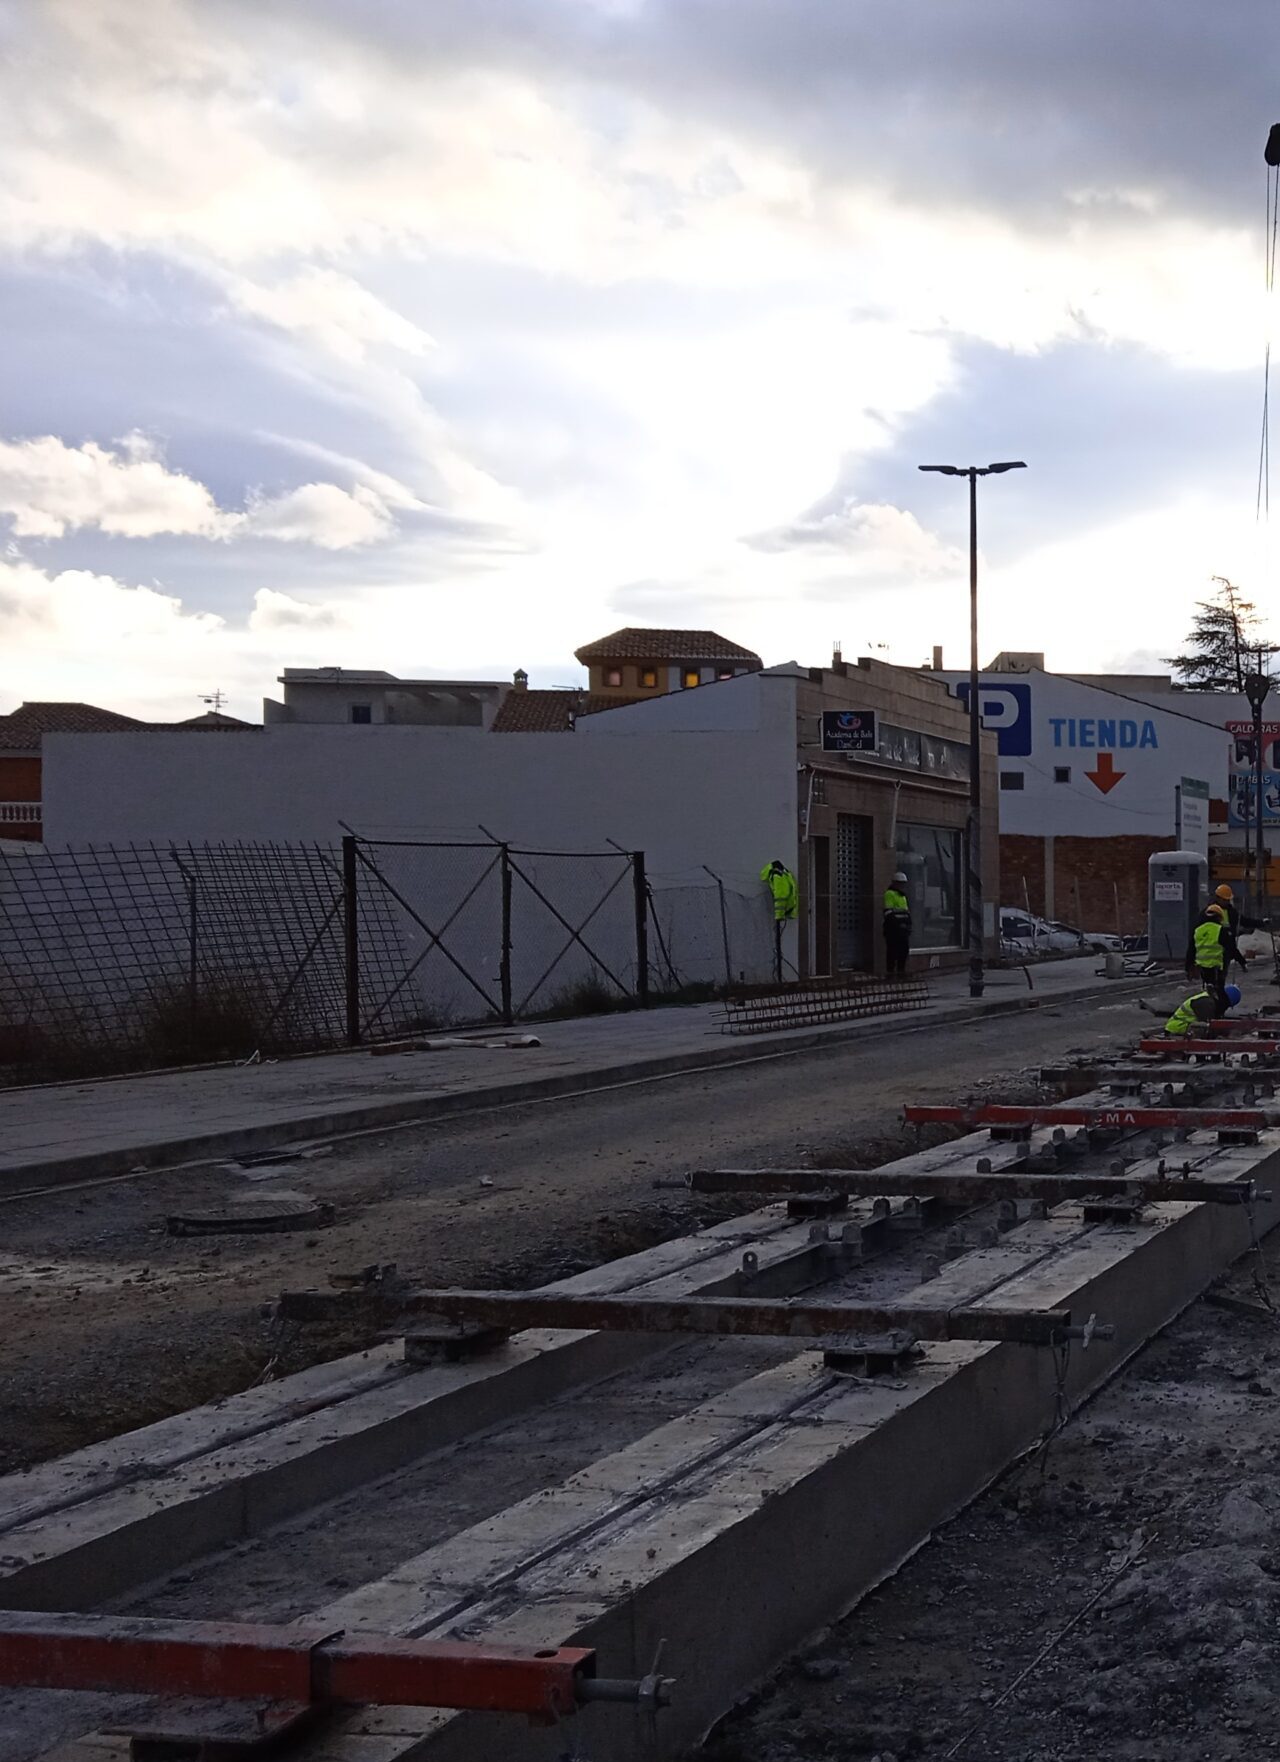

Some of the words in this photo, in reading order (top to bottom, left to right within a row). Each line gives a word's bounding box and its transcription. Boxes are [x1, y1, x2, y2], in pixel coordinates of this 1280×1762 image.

[968, 689, 1019, 728] P
[1049, 718, 1158, 748] TIENDA
[1230, 724, 1278, 734] CALDRAS
